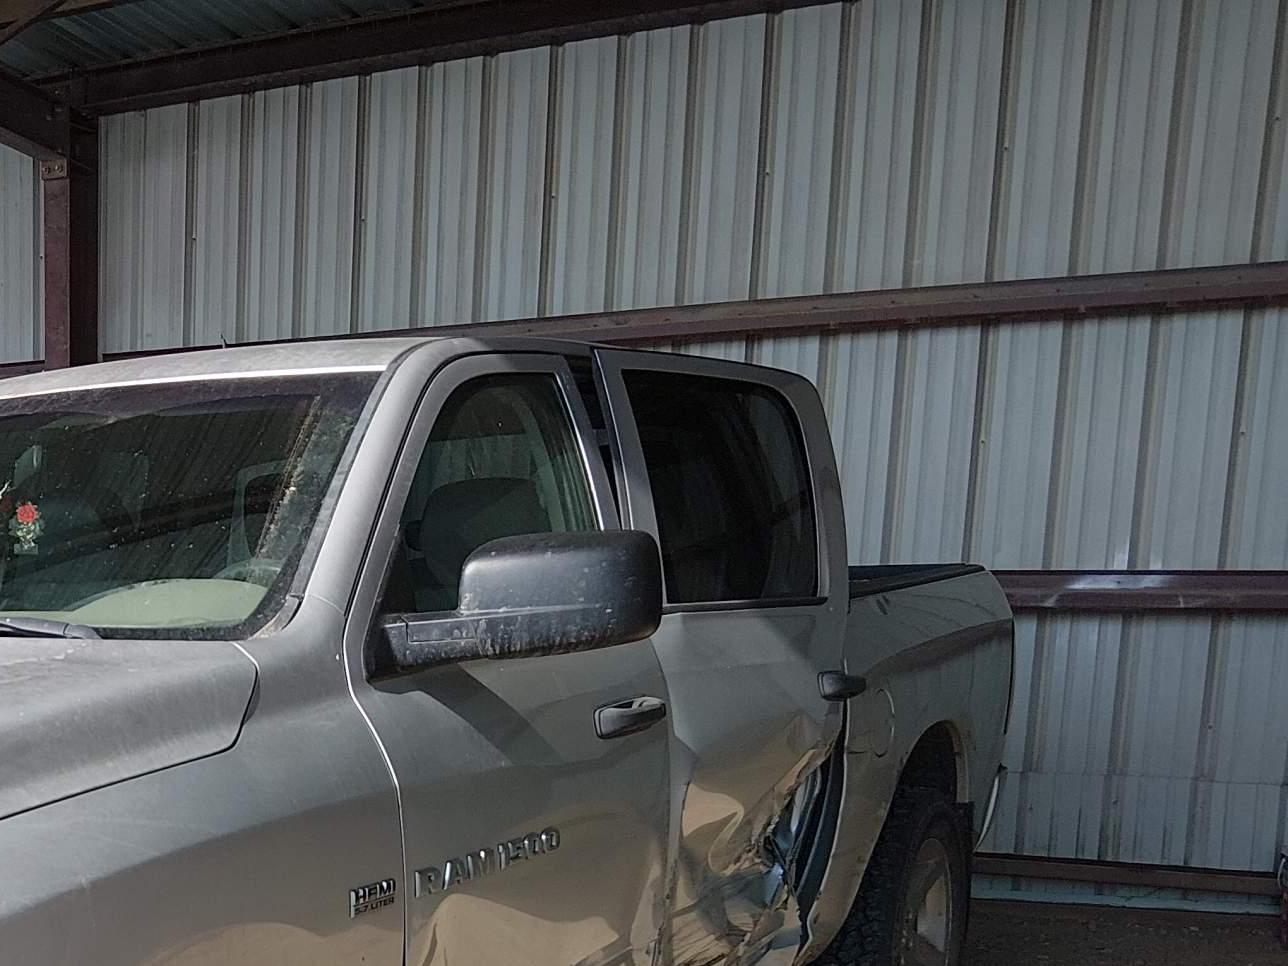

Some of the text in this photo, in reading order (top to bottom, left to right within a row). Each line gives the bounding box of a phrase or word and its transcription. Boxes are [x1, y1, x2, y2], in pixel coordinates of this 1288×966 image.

[414, 826, 561, 899] RAM 1500
[349, 877, 397, 908] HEMI
[370, 896, 396, 911] LITER
